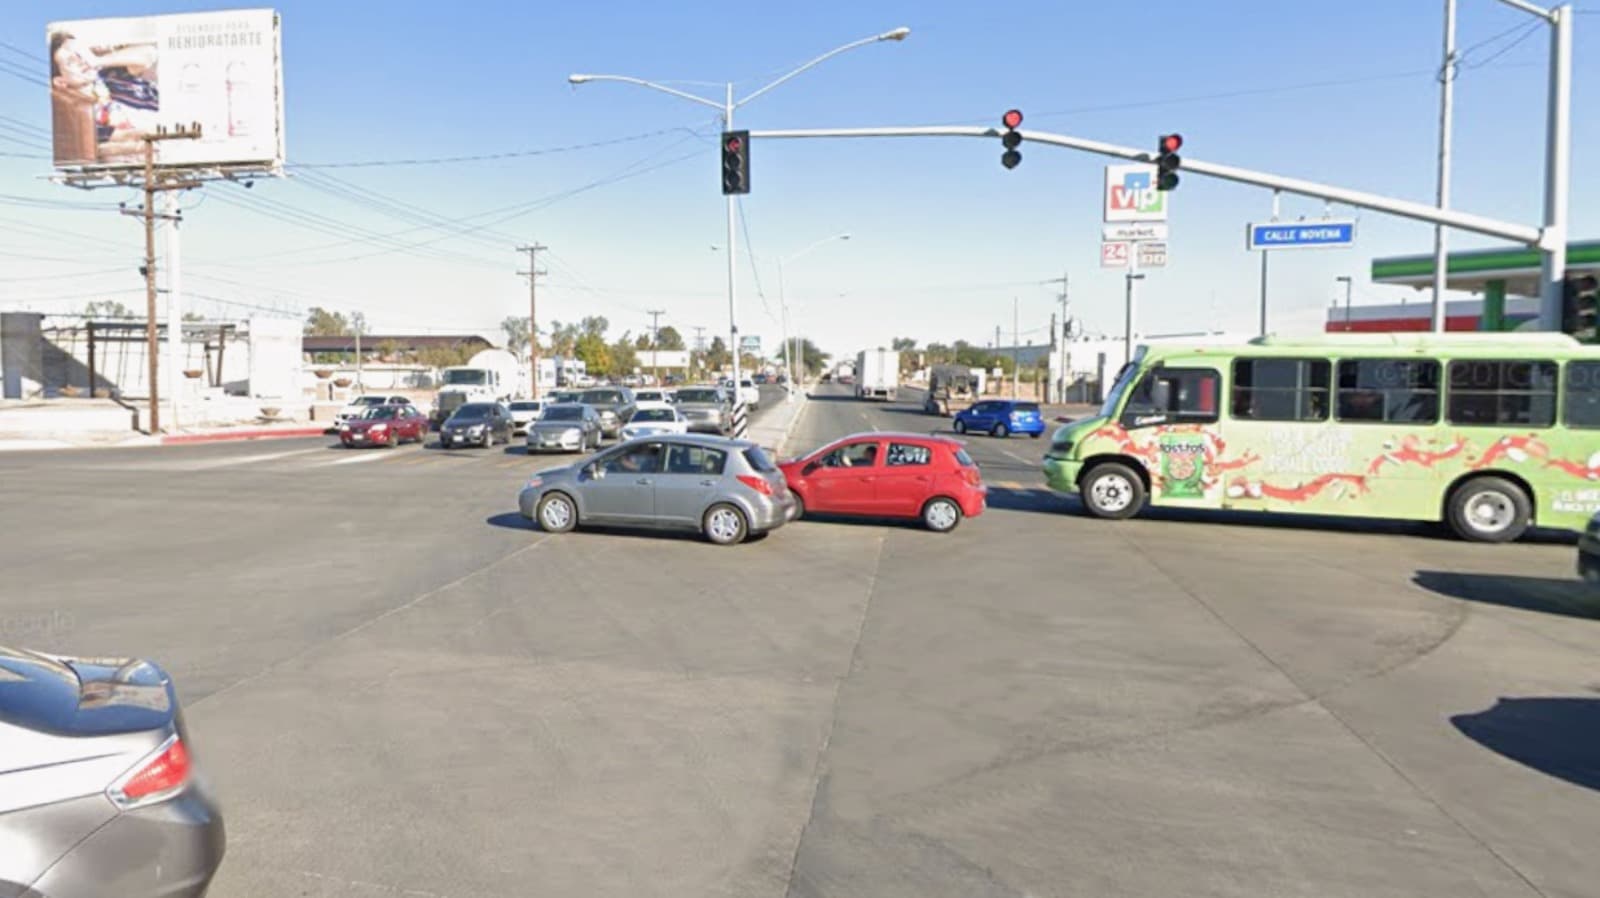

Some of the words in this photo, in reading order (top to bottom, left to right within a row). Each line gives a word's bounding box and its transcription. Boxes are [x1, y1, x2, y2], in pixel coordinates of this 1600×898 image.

[1113, 181, 1161, 212] vip
[1264, 229, 1297, 241] CALLE
[1299, 227, 1342, 240] NOVENA
